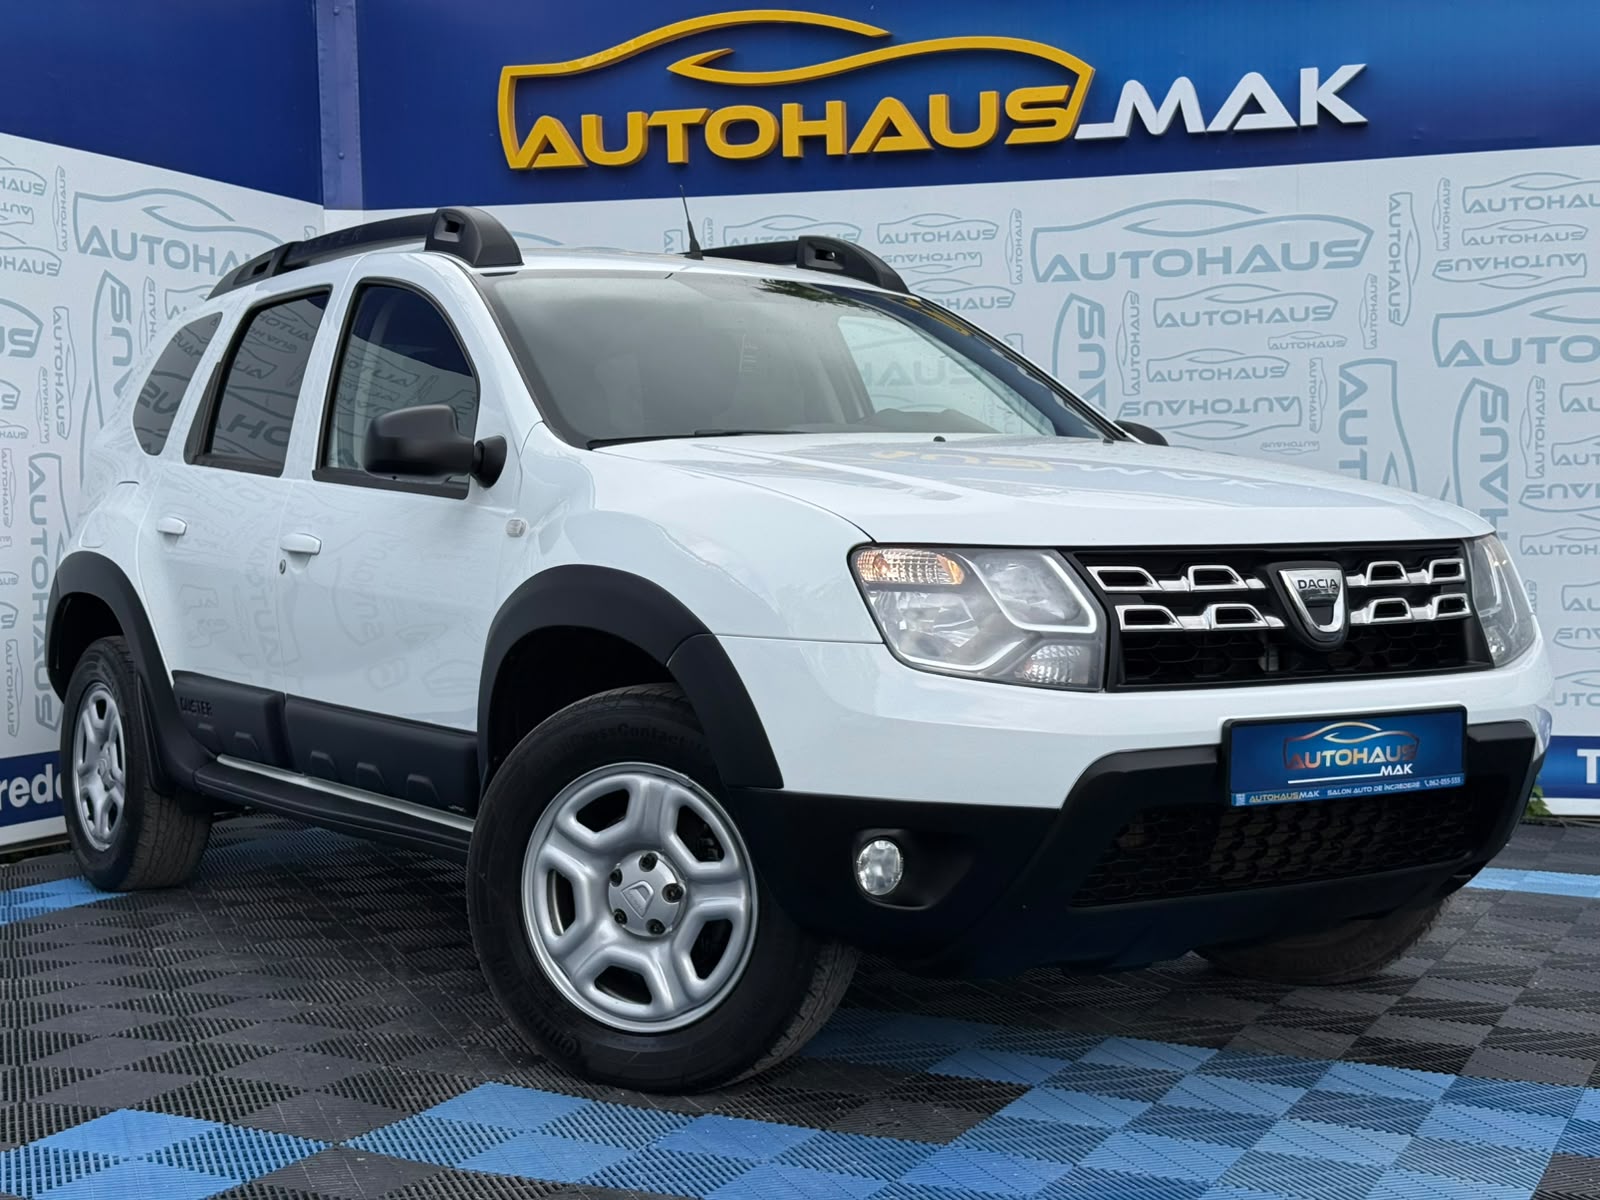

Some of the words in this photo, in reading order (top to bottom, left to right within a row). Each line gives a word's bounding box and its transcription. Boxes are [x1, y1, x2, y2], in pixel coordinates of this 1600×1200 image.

[509, 84, 1075, 169] AUTOHAUS
[1077, 62, 1368, 140] MAK
[1442, 179, 1450, 249] AUTOHAUS
[79, 225, 252, 277] AUTOHA
[880, 228, 997, 244] AUTOHAUS
[1014, 209, 1023, 284] AUTOHAUS
[1464, 230, 1585, 246] AUTOHAUS
[0, 255, 61, 277] HAUS
[1036, 239, 1367, 283] AUTOHAUS
[1389, 193, 1401, 325] AUTOHAUS
[1437, 252, 1585, 273] AUTOHAUS
[1157, 304, 1334, 329] AUTOHAUS
[1369, 275, 1378, 349] AUTOHAUS
[1130, 291, 1140, 395] AUTOHAUS
[1269, 338, 1346, 351] AUTOHAUS
[52, 307, 67, 439] AUTOHAUS
[1149, 365, 1288, 383] AUTOHAUS
[1121, 395, 1300, 417] AUTOHAUS
[1309, 358, 1318, 433] AUTOHAUS
[1535, 378, 1545, 478] AUTOHAUS
[1297, 578, 1339, 590] DACIA
[5, 639, 17, 737] AUTOHAUS
[1285, 744, 1418, 770] AUTOHAUS
[1379, 762, 1413, 777] MAK
[1353, 785, 1373, 794] AUTO
[1374, 784, 1383, 792] DE
